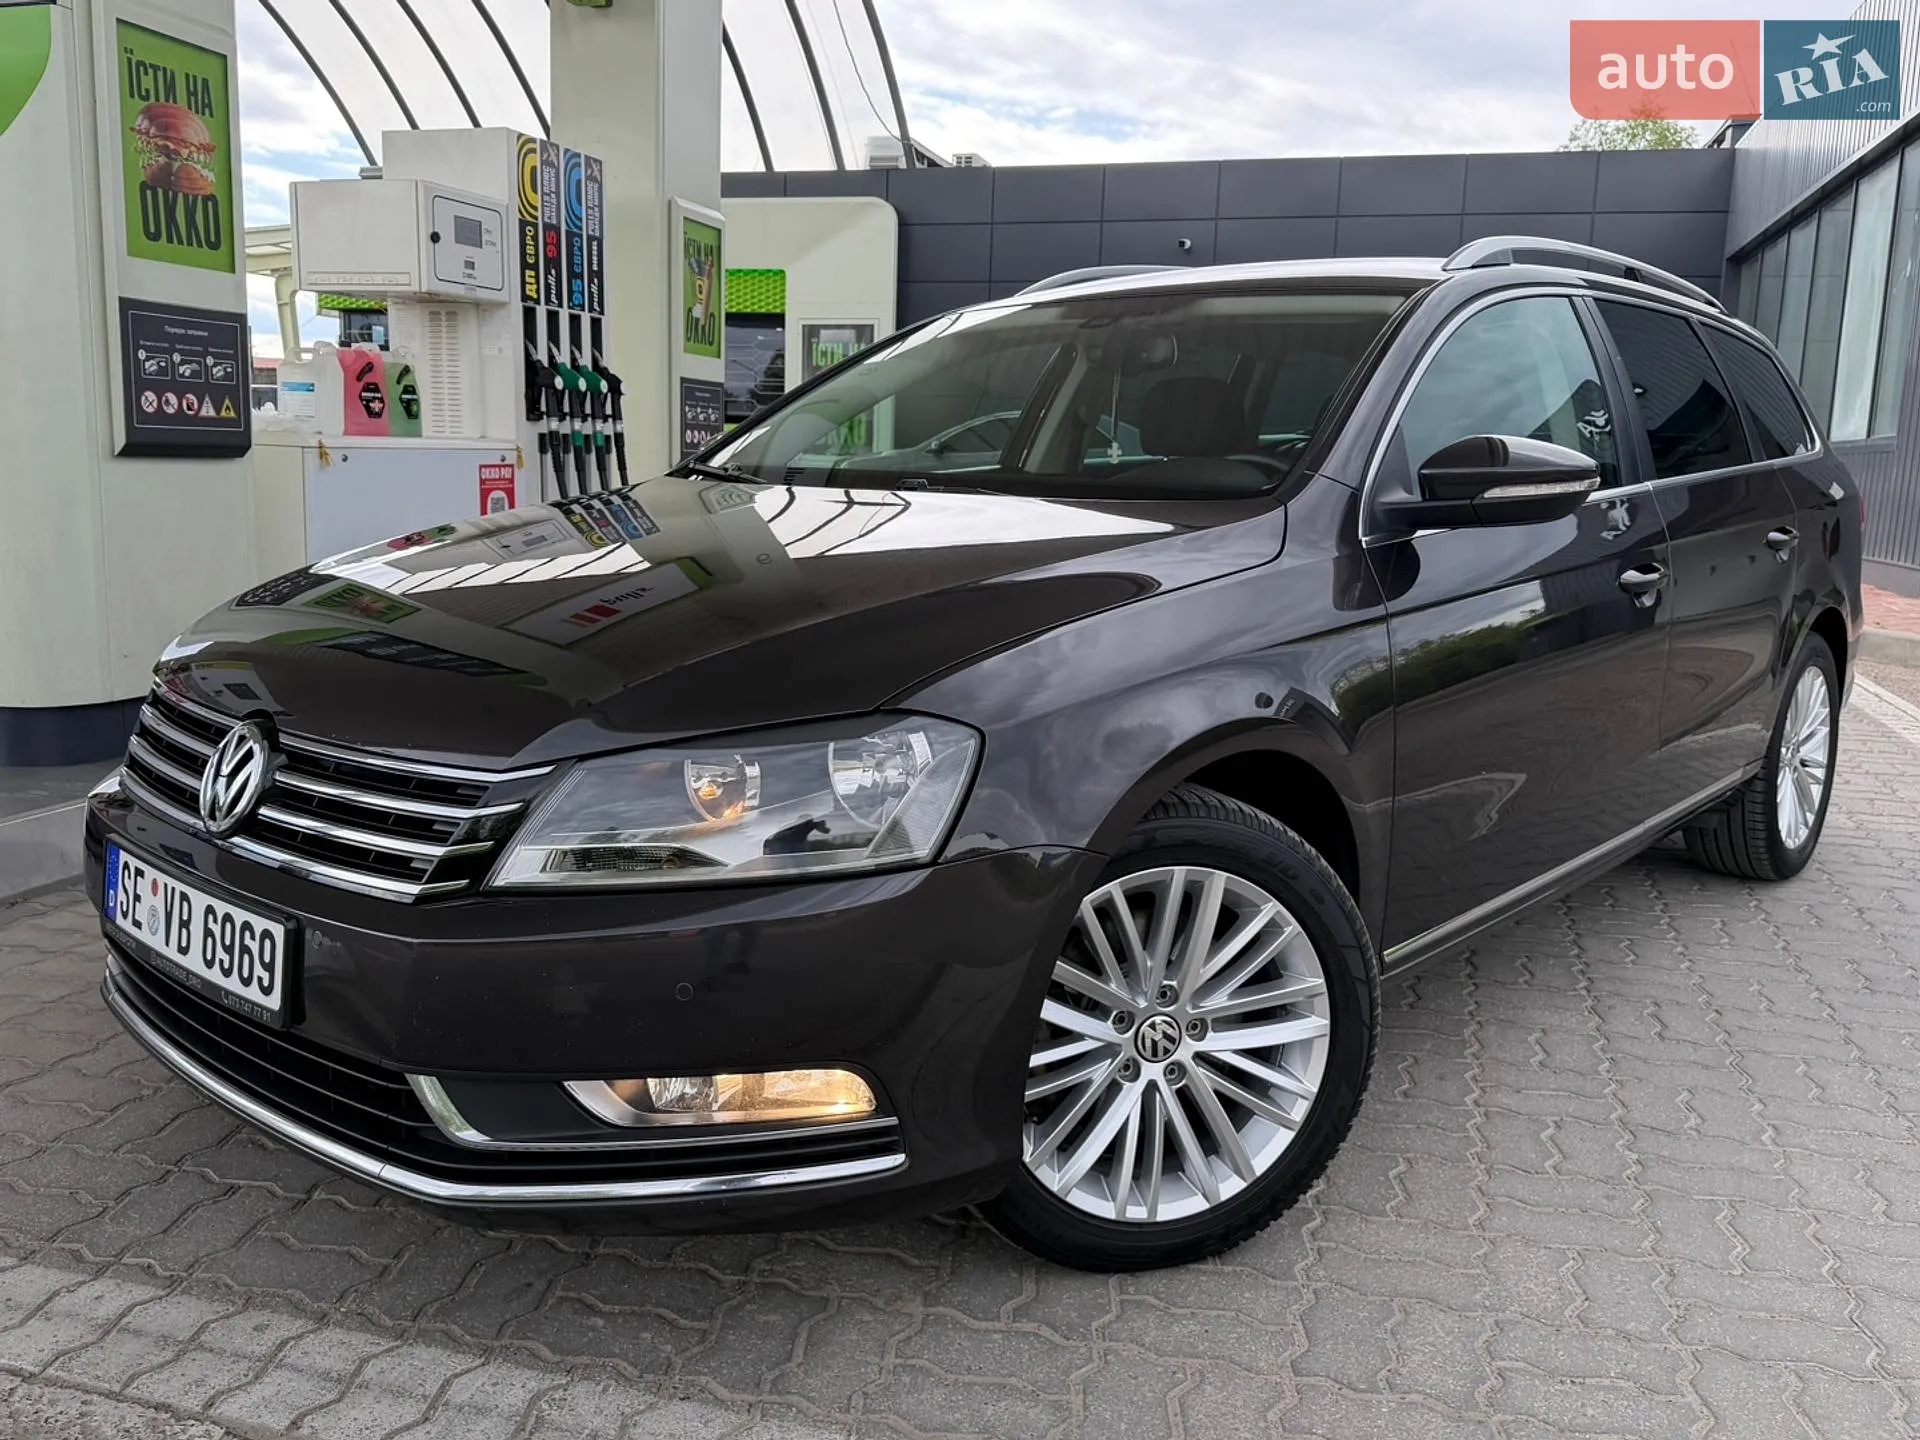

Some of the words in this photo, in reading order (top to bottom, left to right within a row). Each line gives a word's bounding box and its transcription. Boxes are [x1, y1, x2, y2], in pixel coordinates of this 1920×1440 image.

[123, 46, 178, 105] ЇСТИ
[185, 71, 214, 119] НА
[139, 180, 222, 251] ОККО
[525, 225, 536, 264] ЄВРО
[545, 230, 557, 258] 95
[573, 236, 582, 273] ЄВРО
[591, 240, 599, 271] DIESEL
[525, 269, 538, 299] ДП
[572, 278, 583, 307] 95
[686, 306, 716, 346] ОККО
[108, 888, 115, 907] D
[120, 860, 145, 931] SE
[164, 882, 193, 957] VB
[202, 904, 277, 997] 6969
